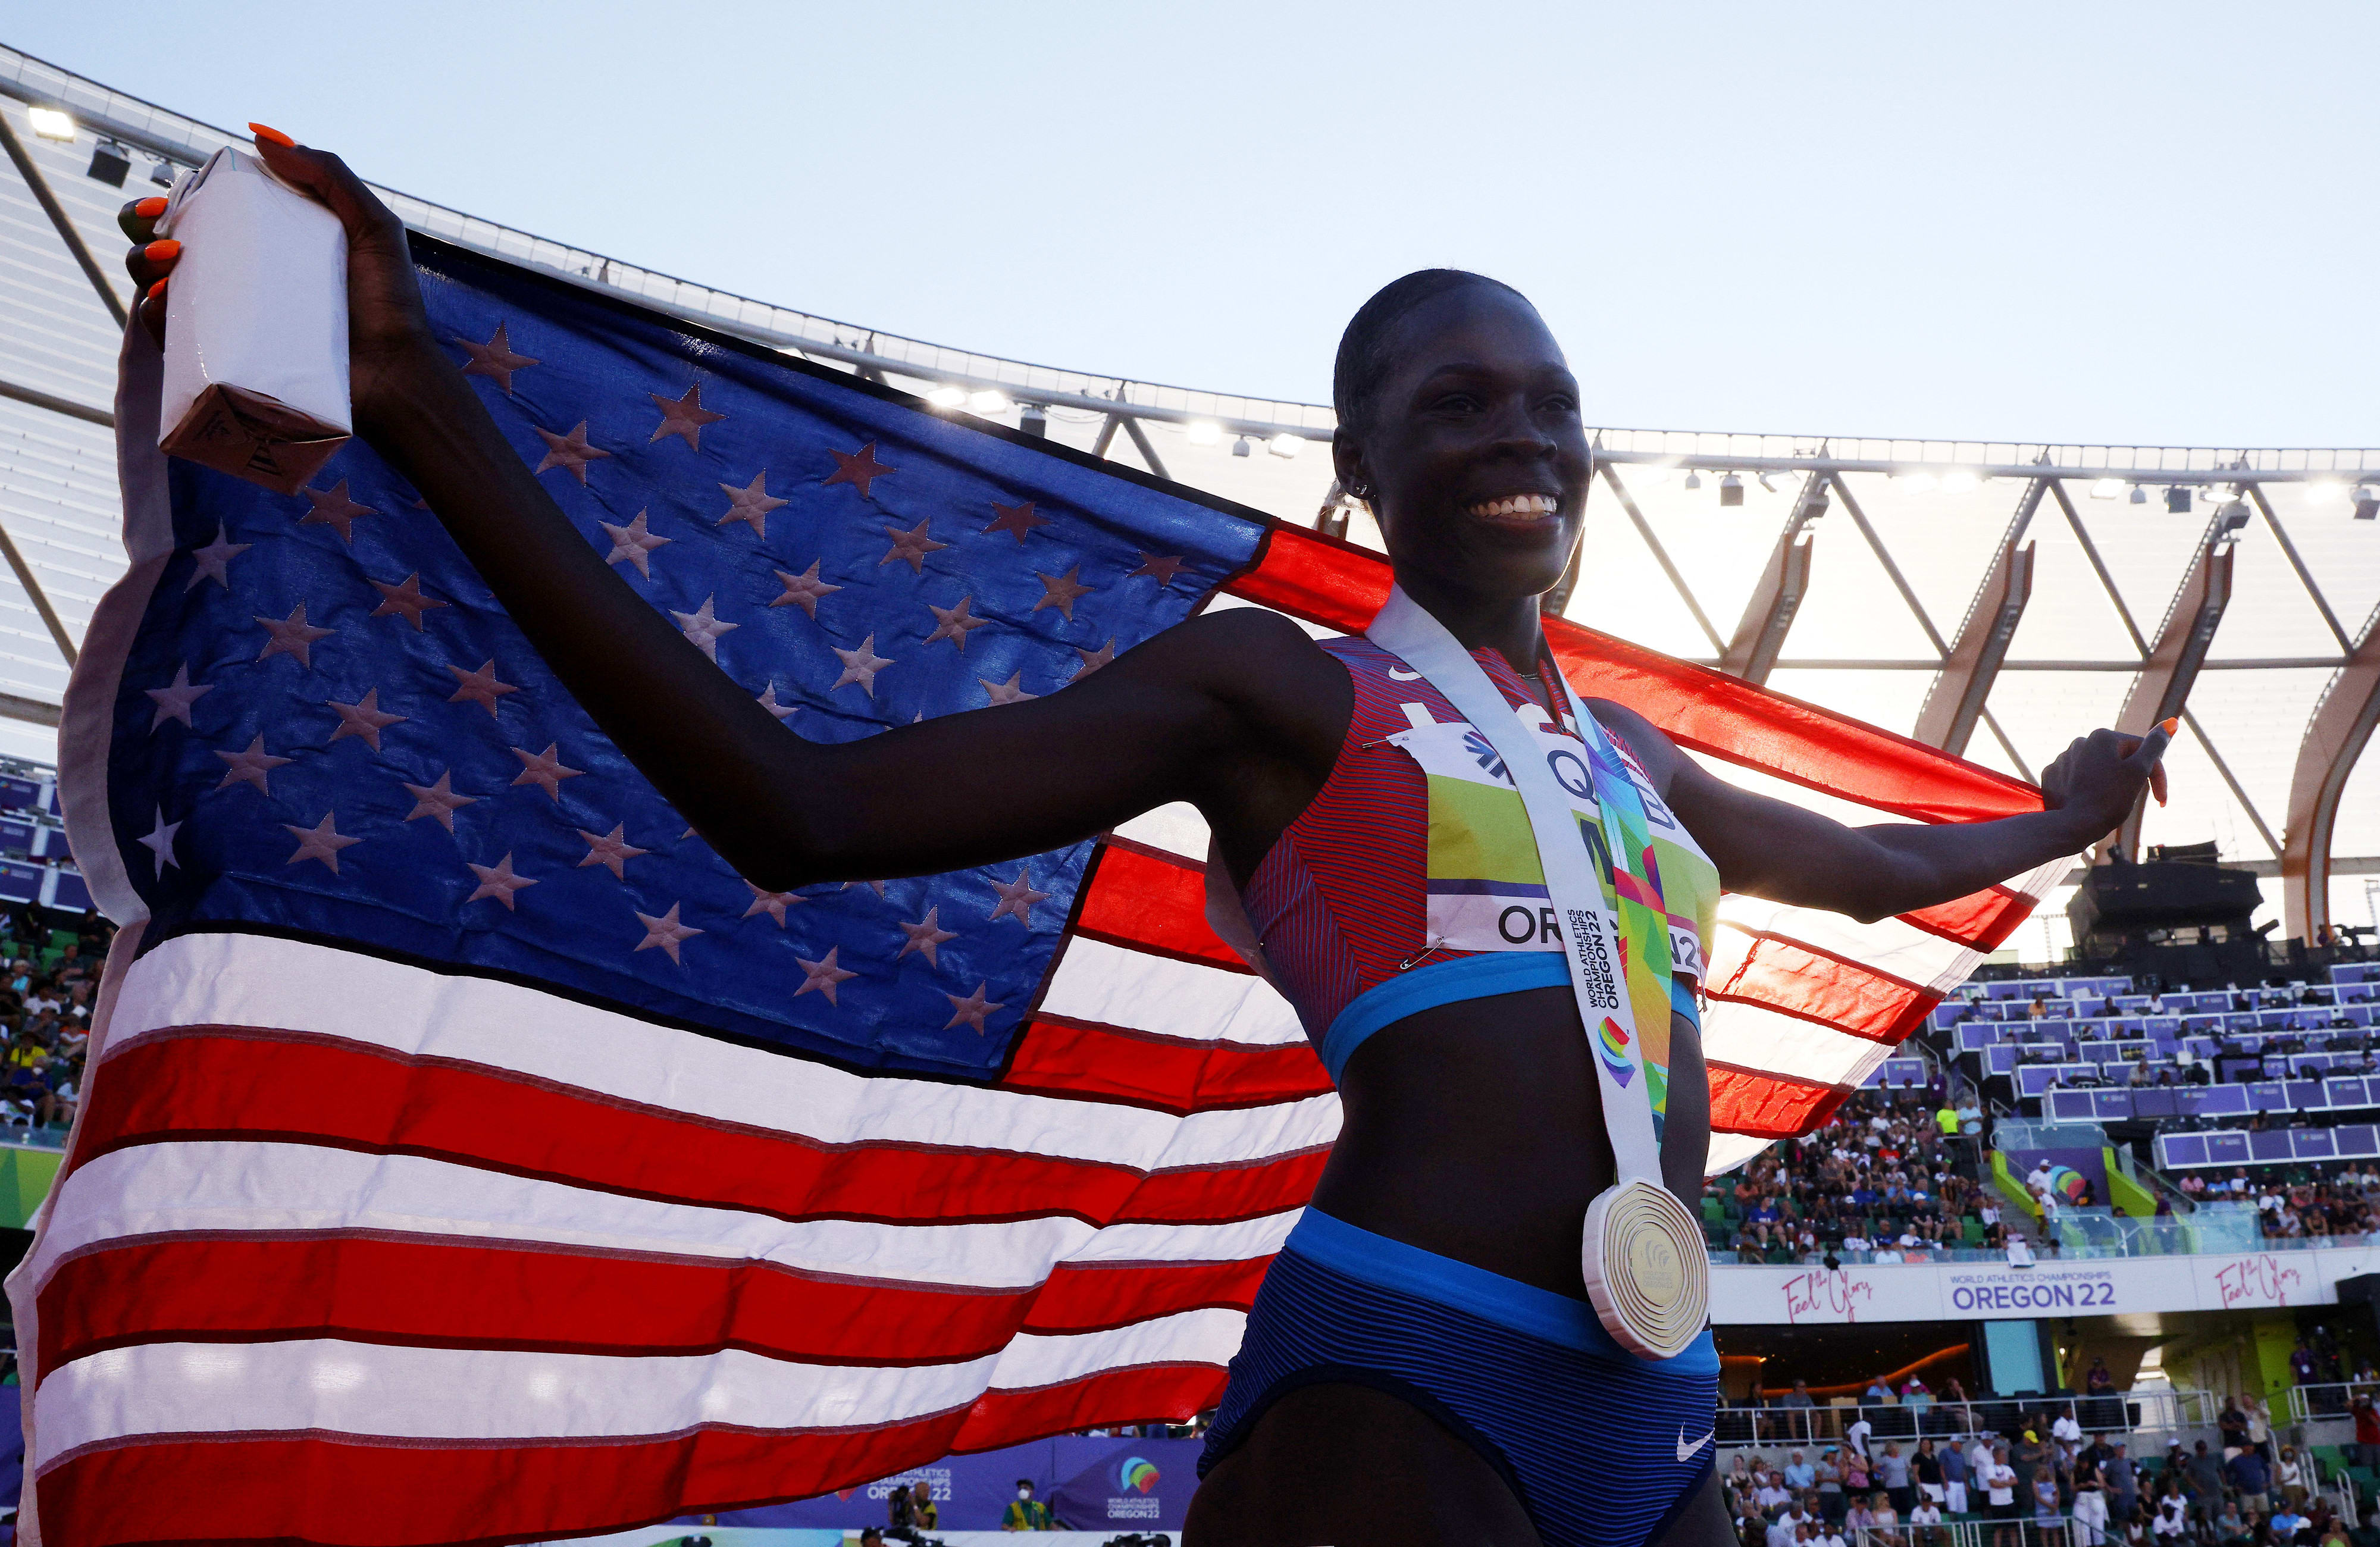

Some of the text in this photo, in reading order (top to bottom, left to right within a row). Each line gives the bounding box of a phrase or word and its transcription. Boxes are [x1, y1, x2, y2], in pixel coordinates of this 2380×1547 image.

[1567, 909, 1598, 1008] WORLD ATHLETICS
[1576, 910, 1606, 1009] CHAMPIONSHIPS
[1950, 1270, 2112, 1284] WORLD ATHLETICS CHAMPIONSHIPS
